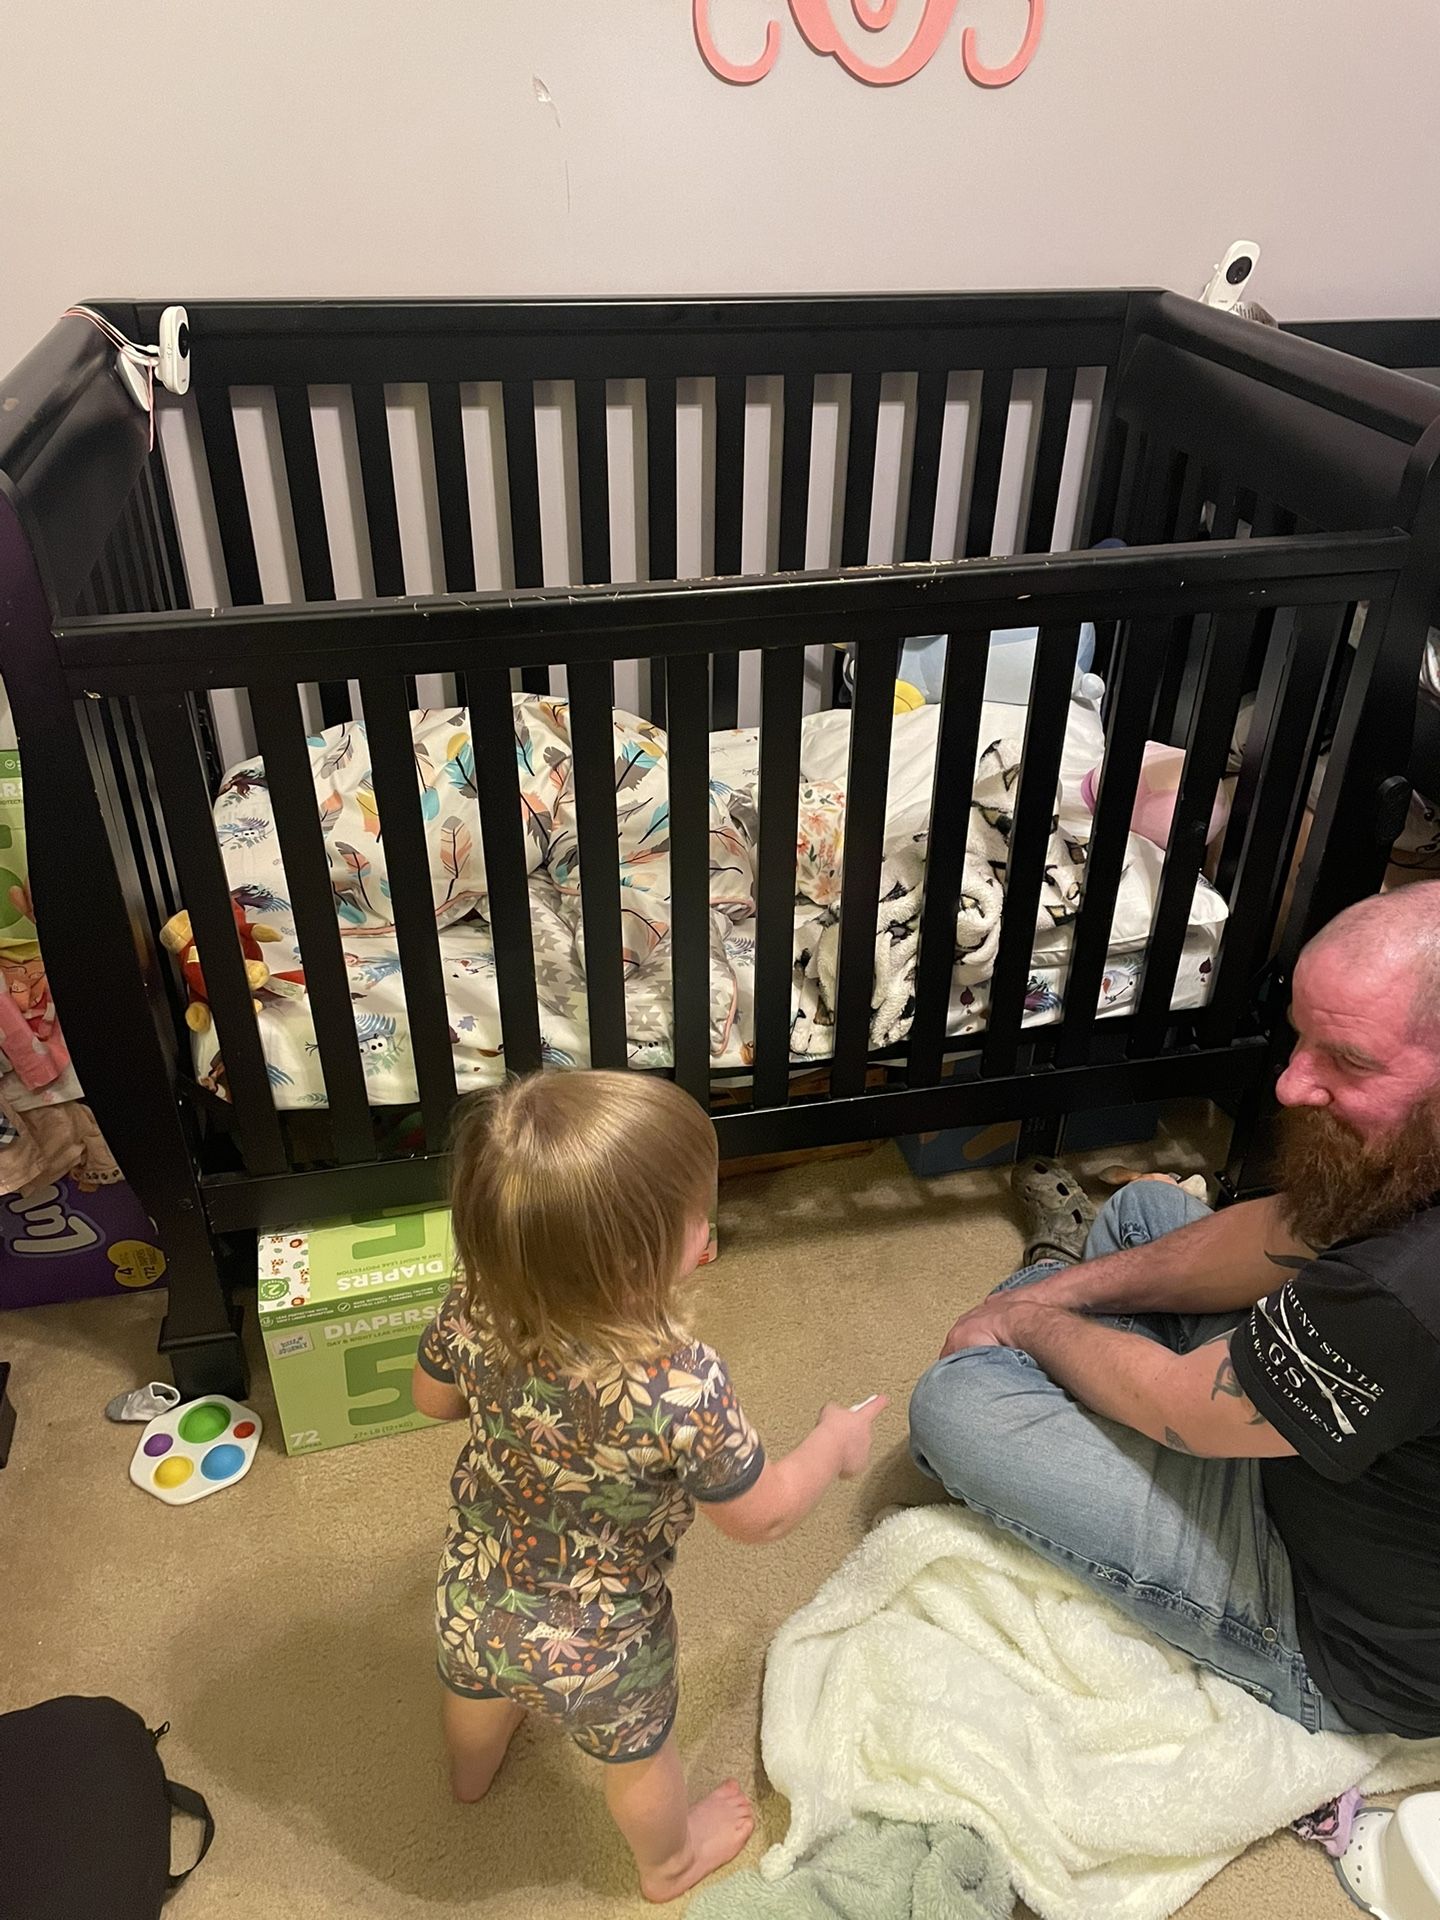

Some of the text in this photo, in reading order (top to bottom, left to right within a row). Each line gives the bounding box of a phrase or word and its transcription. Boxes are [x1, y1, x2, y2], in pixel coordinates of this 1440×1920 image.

[336, 1260, 445, 1291] DIAPERS
[323, 1306, 437, 1340] DIAPERS
[344, 1335, 422, 1427] 5
[1319, 1341, 1385, 1396] STYLE
[1282, 1387, 1343, 1443] DEFEND
[1330, 1382, 1370, 1417] 1776
[290, 1430, 321, 1447] 72
